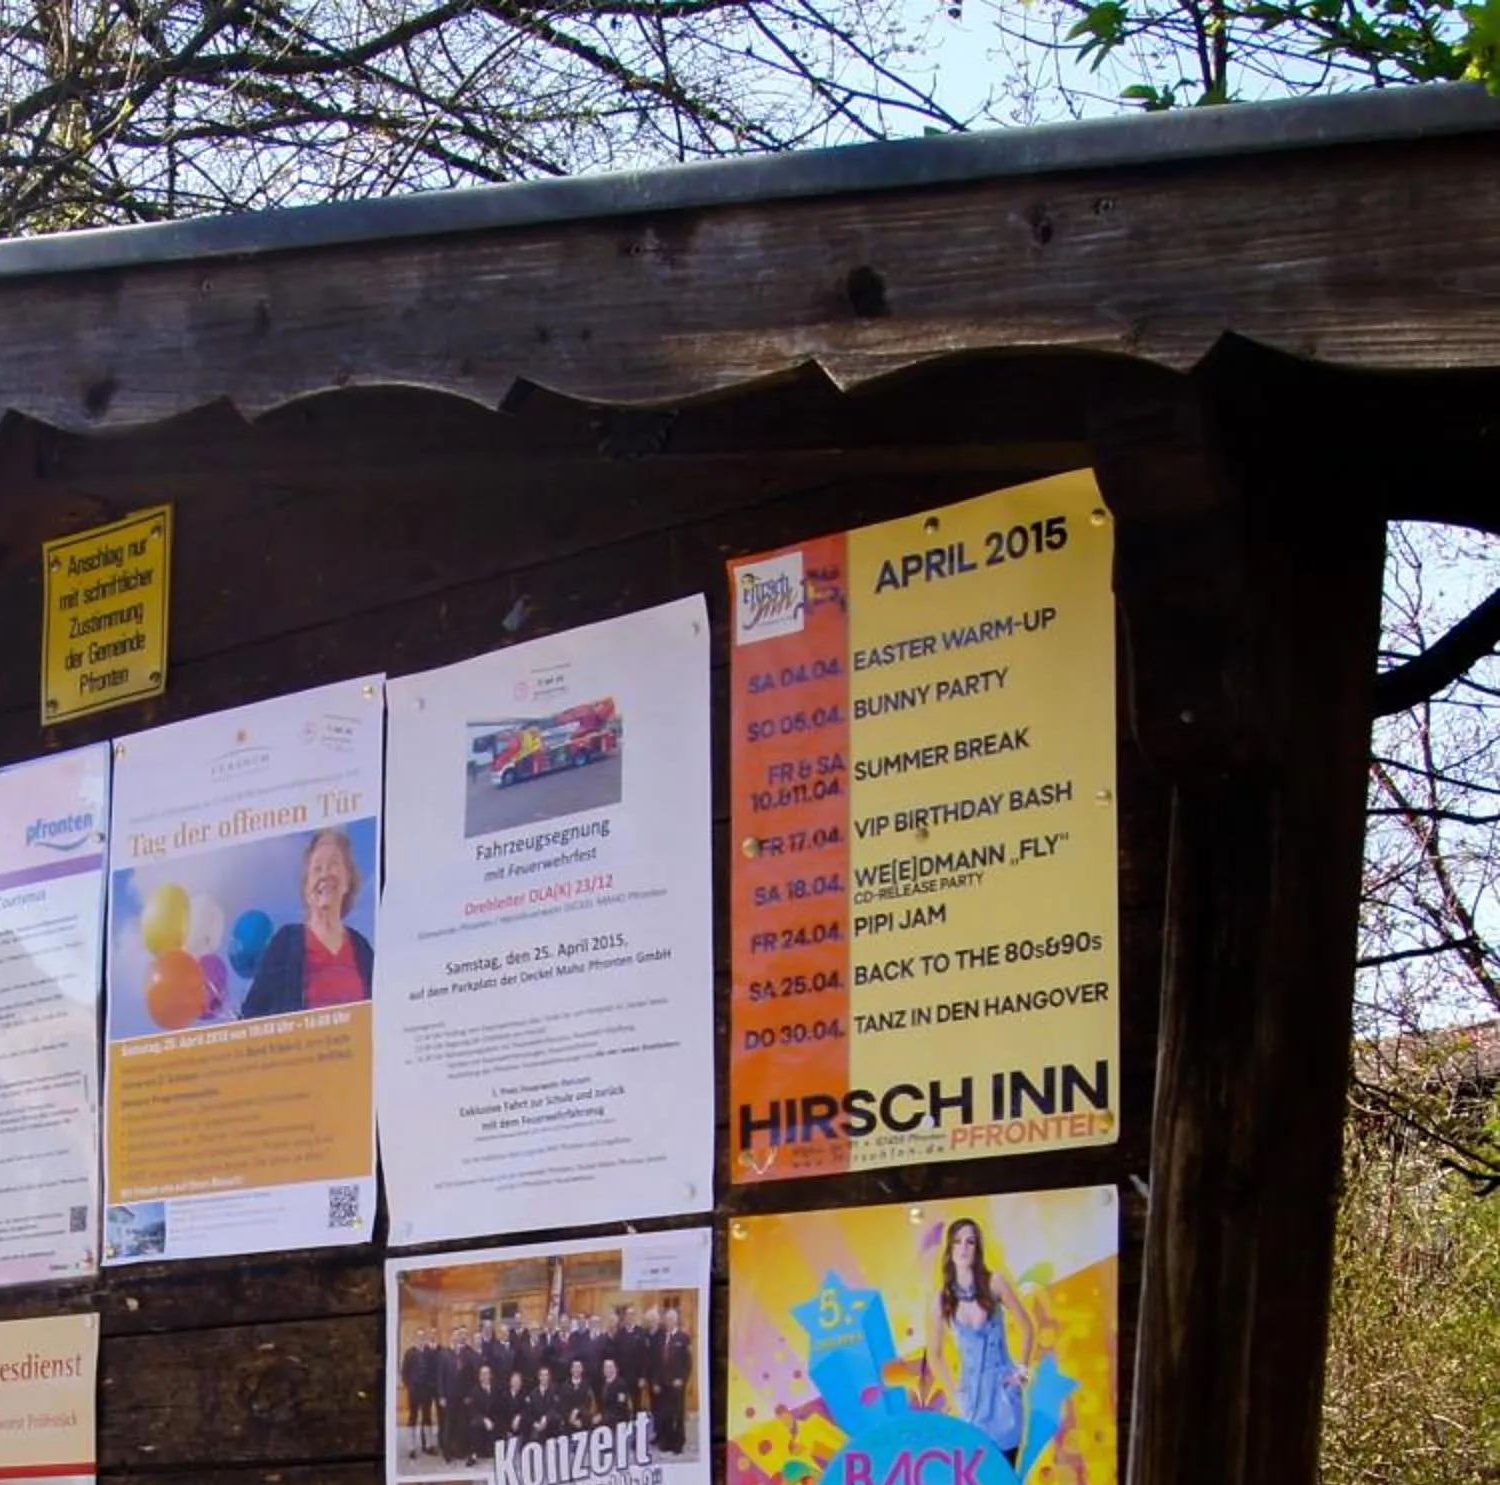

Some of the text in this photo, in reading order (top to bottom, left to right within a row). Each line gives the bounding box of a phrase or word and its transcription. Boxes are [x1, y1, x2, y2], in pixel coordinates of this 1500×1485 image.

[68, 536, 148, 577] Anschlag nur
[874, 515, 1069, 595] APRIL 2015
[59, 591, 79, 611] mit
[68, 601, 145, 639] Zustimmung
[64, 633, 146, 671] der Gemeinde
[853, 607, 1058, 671] EASTER WARM-UP
[78, 667, 129, 695] Pfronten
[748, 657, 843, 695] SA 04.04.
[854, 666, 1009, 721] BUNNY PARTY
[748, 706, 845, 742] SO 05.04.
[768, 753, 846, 786] FR & SA
[854, 727, 1031, 782] SUMMER BREAK
[25, 812, 94, 846] pfronten
[127, 789, 364, 861] Tag der offenen Tür
[854, 781, 1074, 840] VIP BIRTHDAY BASH
[475, 818, 611, 861] Fahrzeugsegnung
[758, 826, 844, 858] FR 17.04.
[483, 847, 598, 884] mit Feuerwehrfest
[573, 873, 614, 897] 23/12
[754, 873, 845, 908] SA 18.04.
[853, 871, 985, 906] CD-RELEASE PARTY
[750, 920, 845, 954] FR 24.04.
[855, 903, 947, 938] PIPI JAM
[445, 932, 630, 978] Samstag, den 25. April 2015,
[855, 930, 1103, 986] BACK TO THE 80s&90s
[749, 970, 845, 1002] SA 25.04.
[854, 981, 1110, 1036] TANZ IN DEN HANGOVER
[744, 1018, 846, 1052] DO 30.04.
[740, 1059, 1111, 1152] HIRSCH INN
